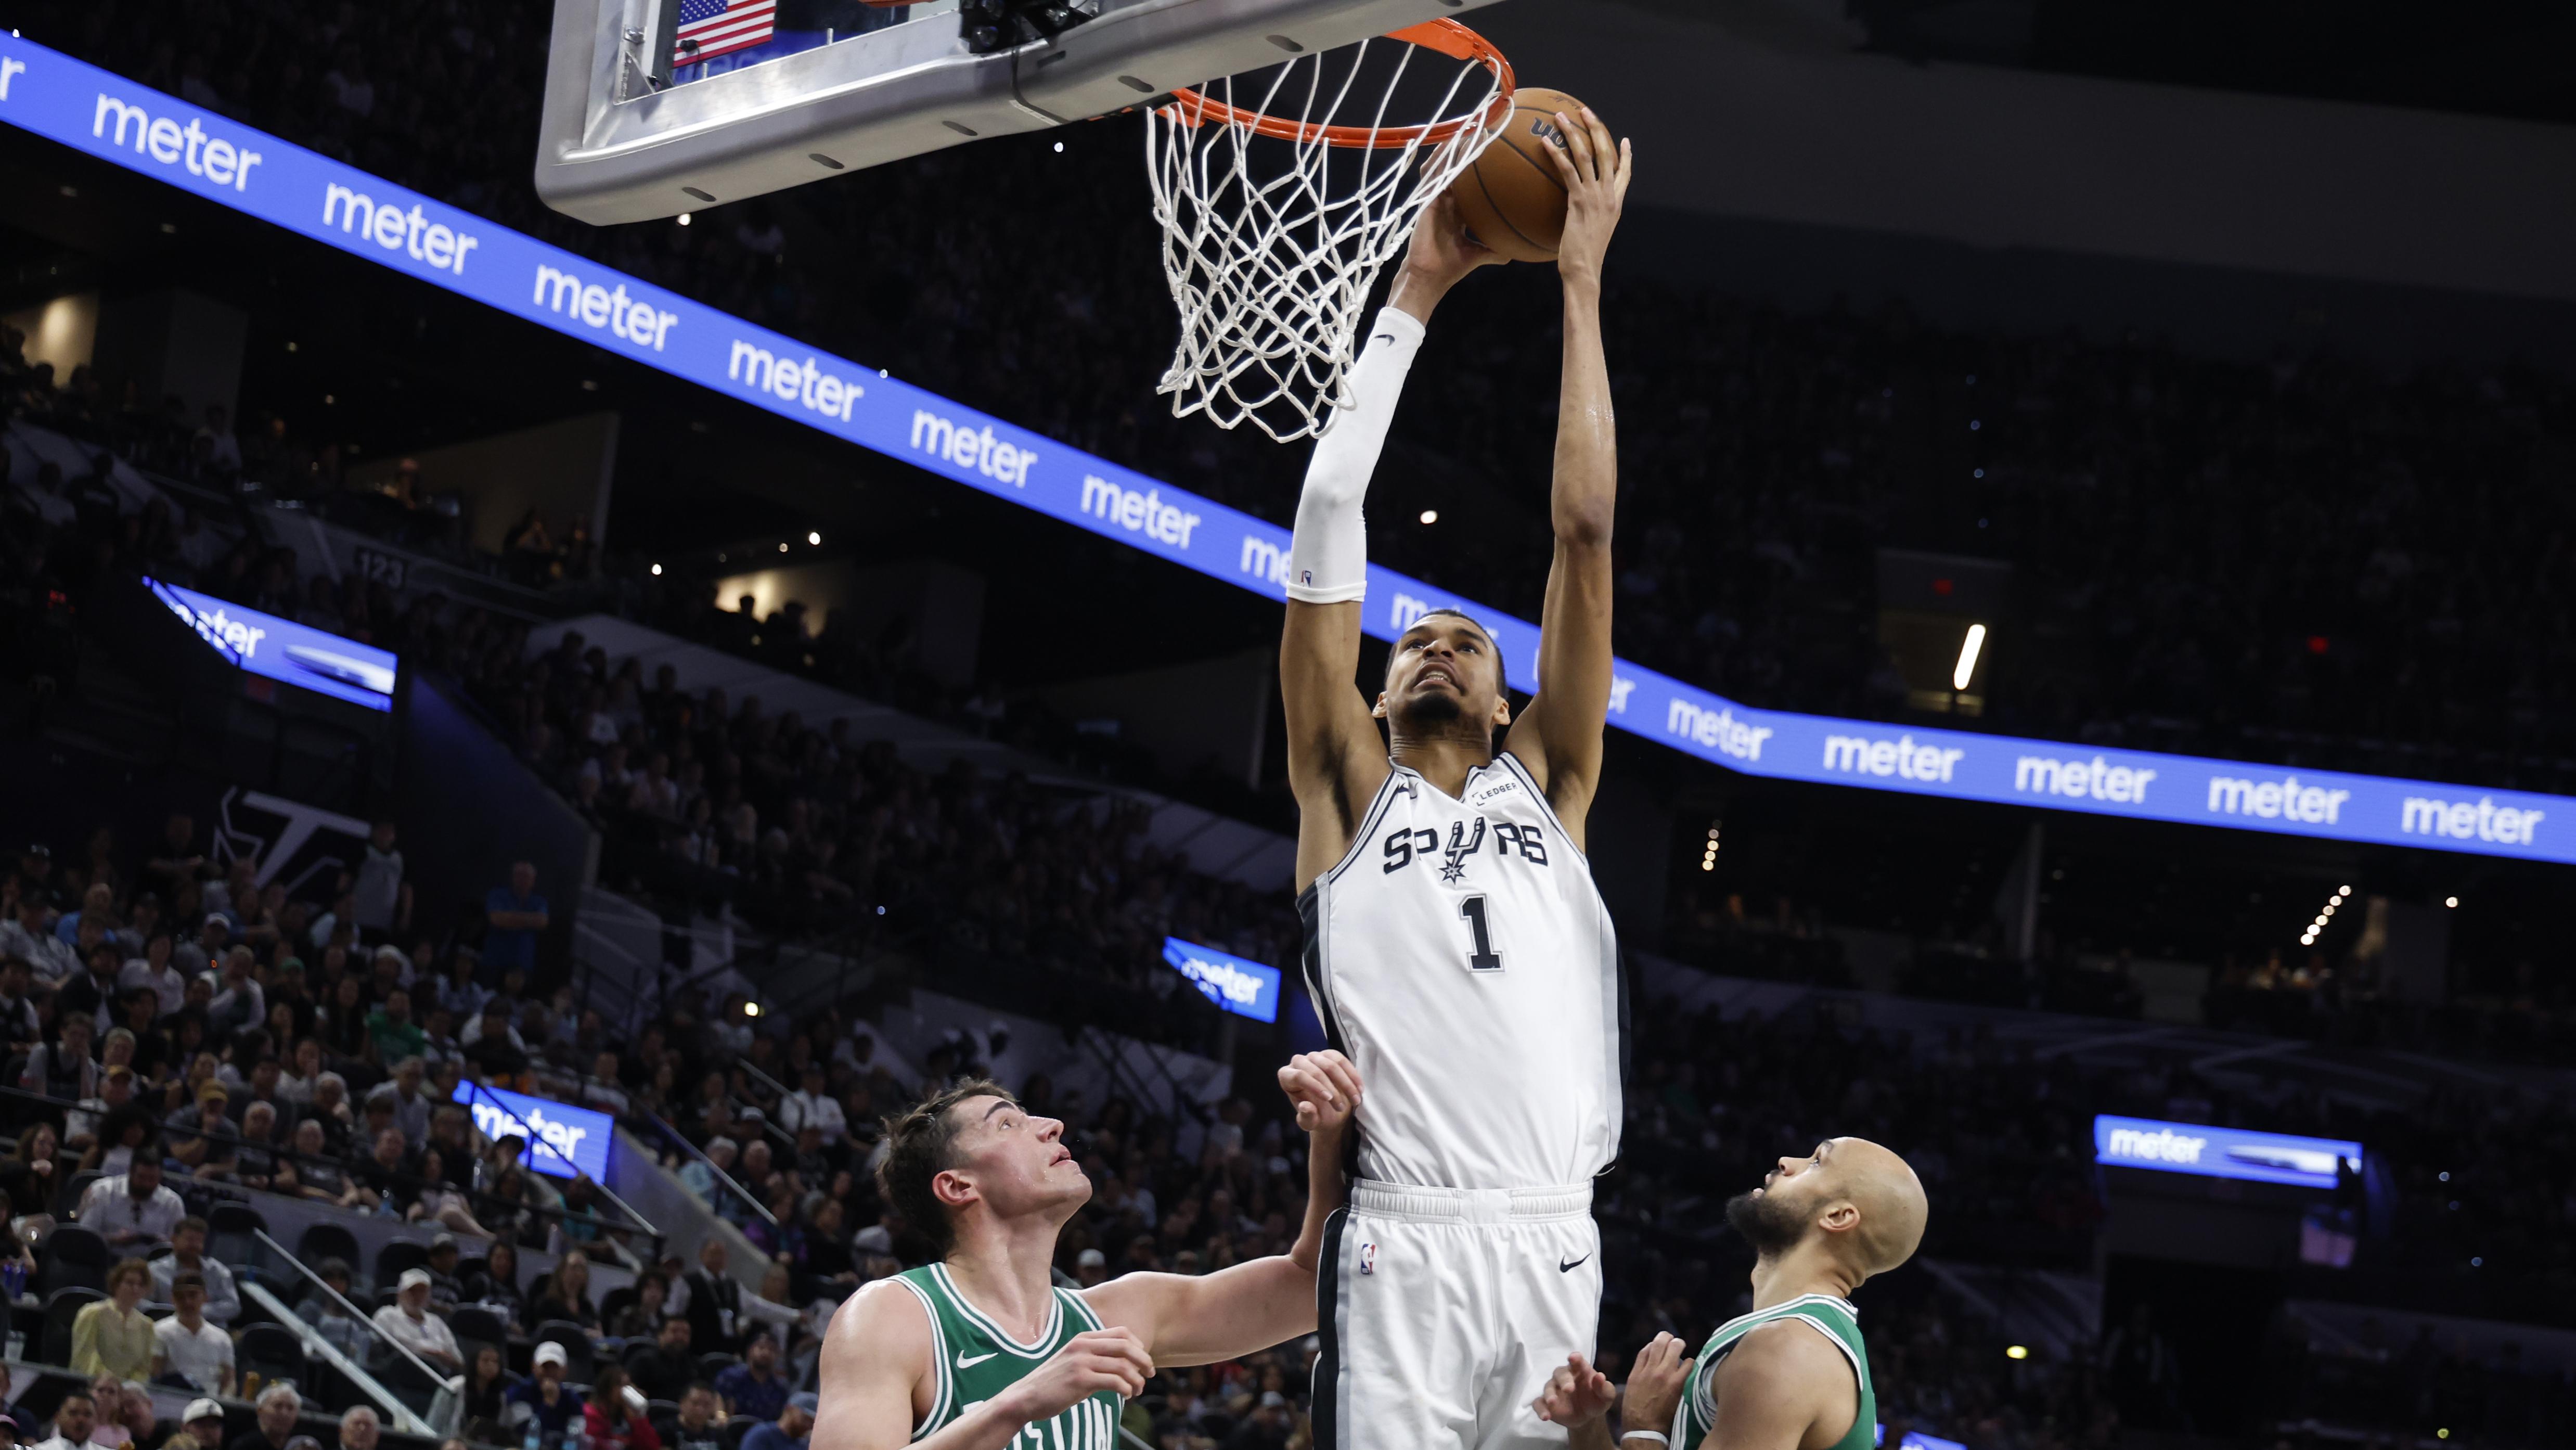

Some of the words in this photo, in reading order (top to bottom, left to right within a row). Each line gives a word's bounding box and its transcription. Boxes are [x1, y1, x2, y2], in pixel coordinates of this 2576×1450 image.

[93, 93, 262, 191] meter
[323, 182, 479, 275] meter
[533, 264, 679, 352] meter
[728, 339, 865, 422] meter
[910, 409, 1038, 488] meter
[1080, 474, 1201, 549] meter
[358, 550, 404, 589] 123
[1667, 698, 1773, 761] meter
[1823, 734, 1965, 784] meter
[1479, 782, 1518, 800] LEDGER
[2014, 755, 2157, 804] meter
[2207, 776, 2350, 825] meter
[1383, 817, 1549, 884] SPURS
[2401, 797, 2545, 845] meter
[1459, 894, 1504, 972] 1
[1180, 956, 1265, 1006] meter
[2108, 1127, 2208, 1164] meter
